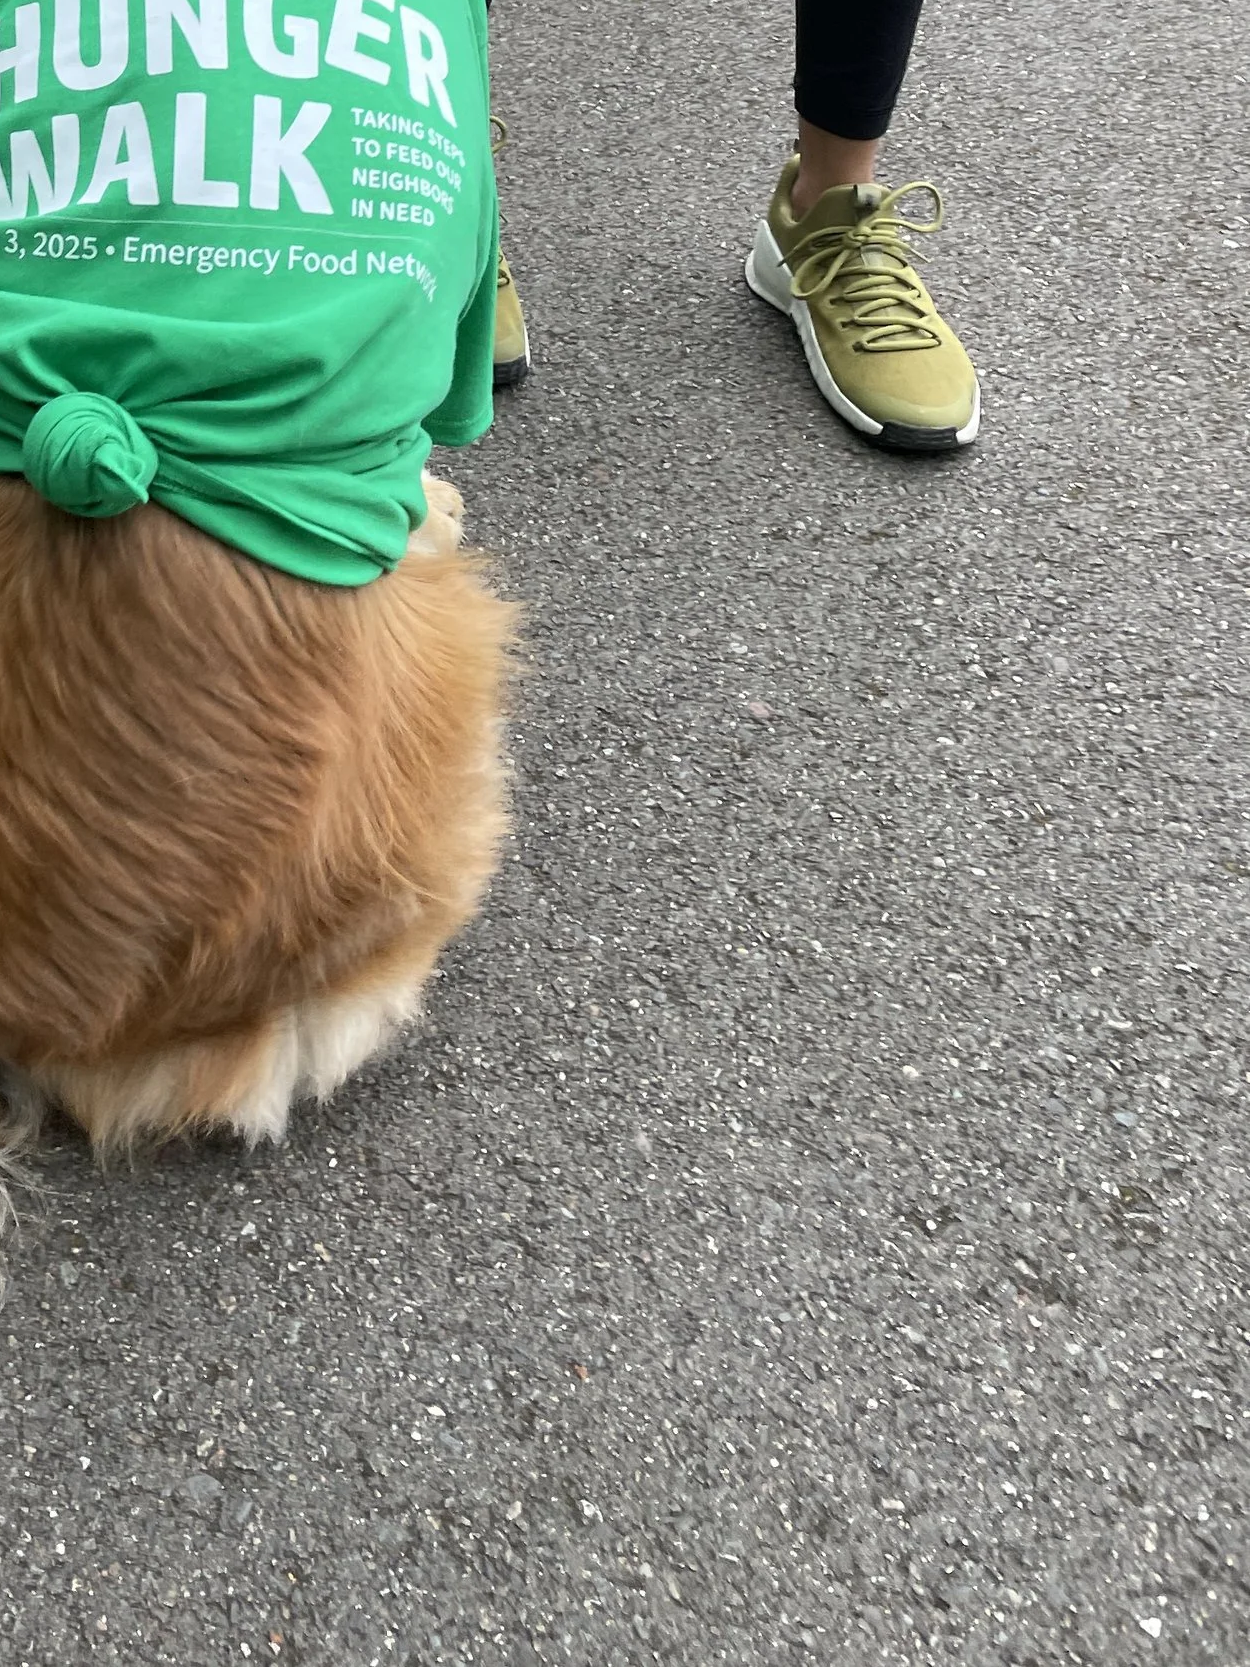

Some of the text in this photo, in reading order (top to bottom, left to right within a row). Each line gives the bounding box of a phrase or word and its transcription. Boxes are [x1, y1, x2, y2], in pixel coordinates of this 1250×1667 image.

[350, 107, 465, 167] TAKING STEPS
[351, 137, 461, 192] TO FEED OUR
[351, 198, 434, 226] IN NEED
[352, 167, 454, 215] NEIGHBORS
[4, 229, 25, 259] 3,
[32, 232, 98, 260] 2025
[123, 236, 280, 275] Emergency
[288, 245, 357, 275] Food
